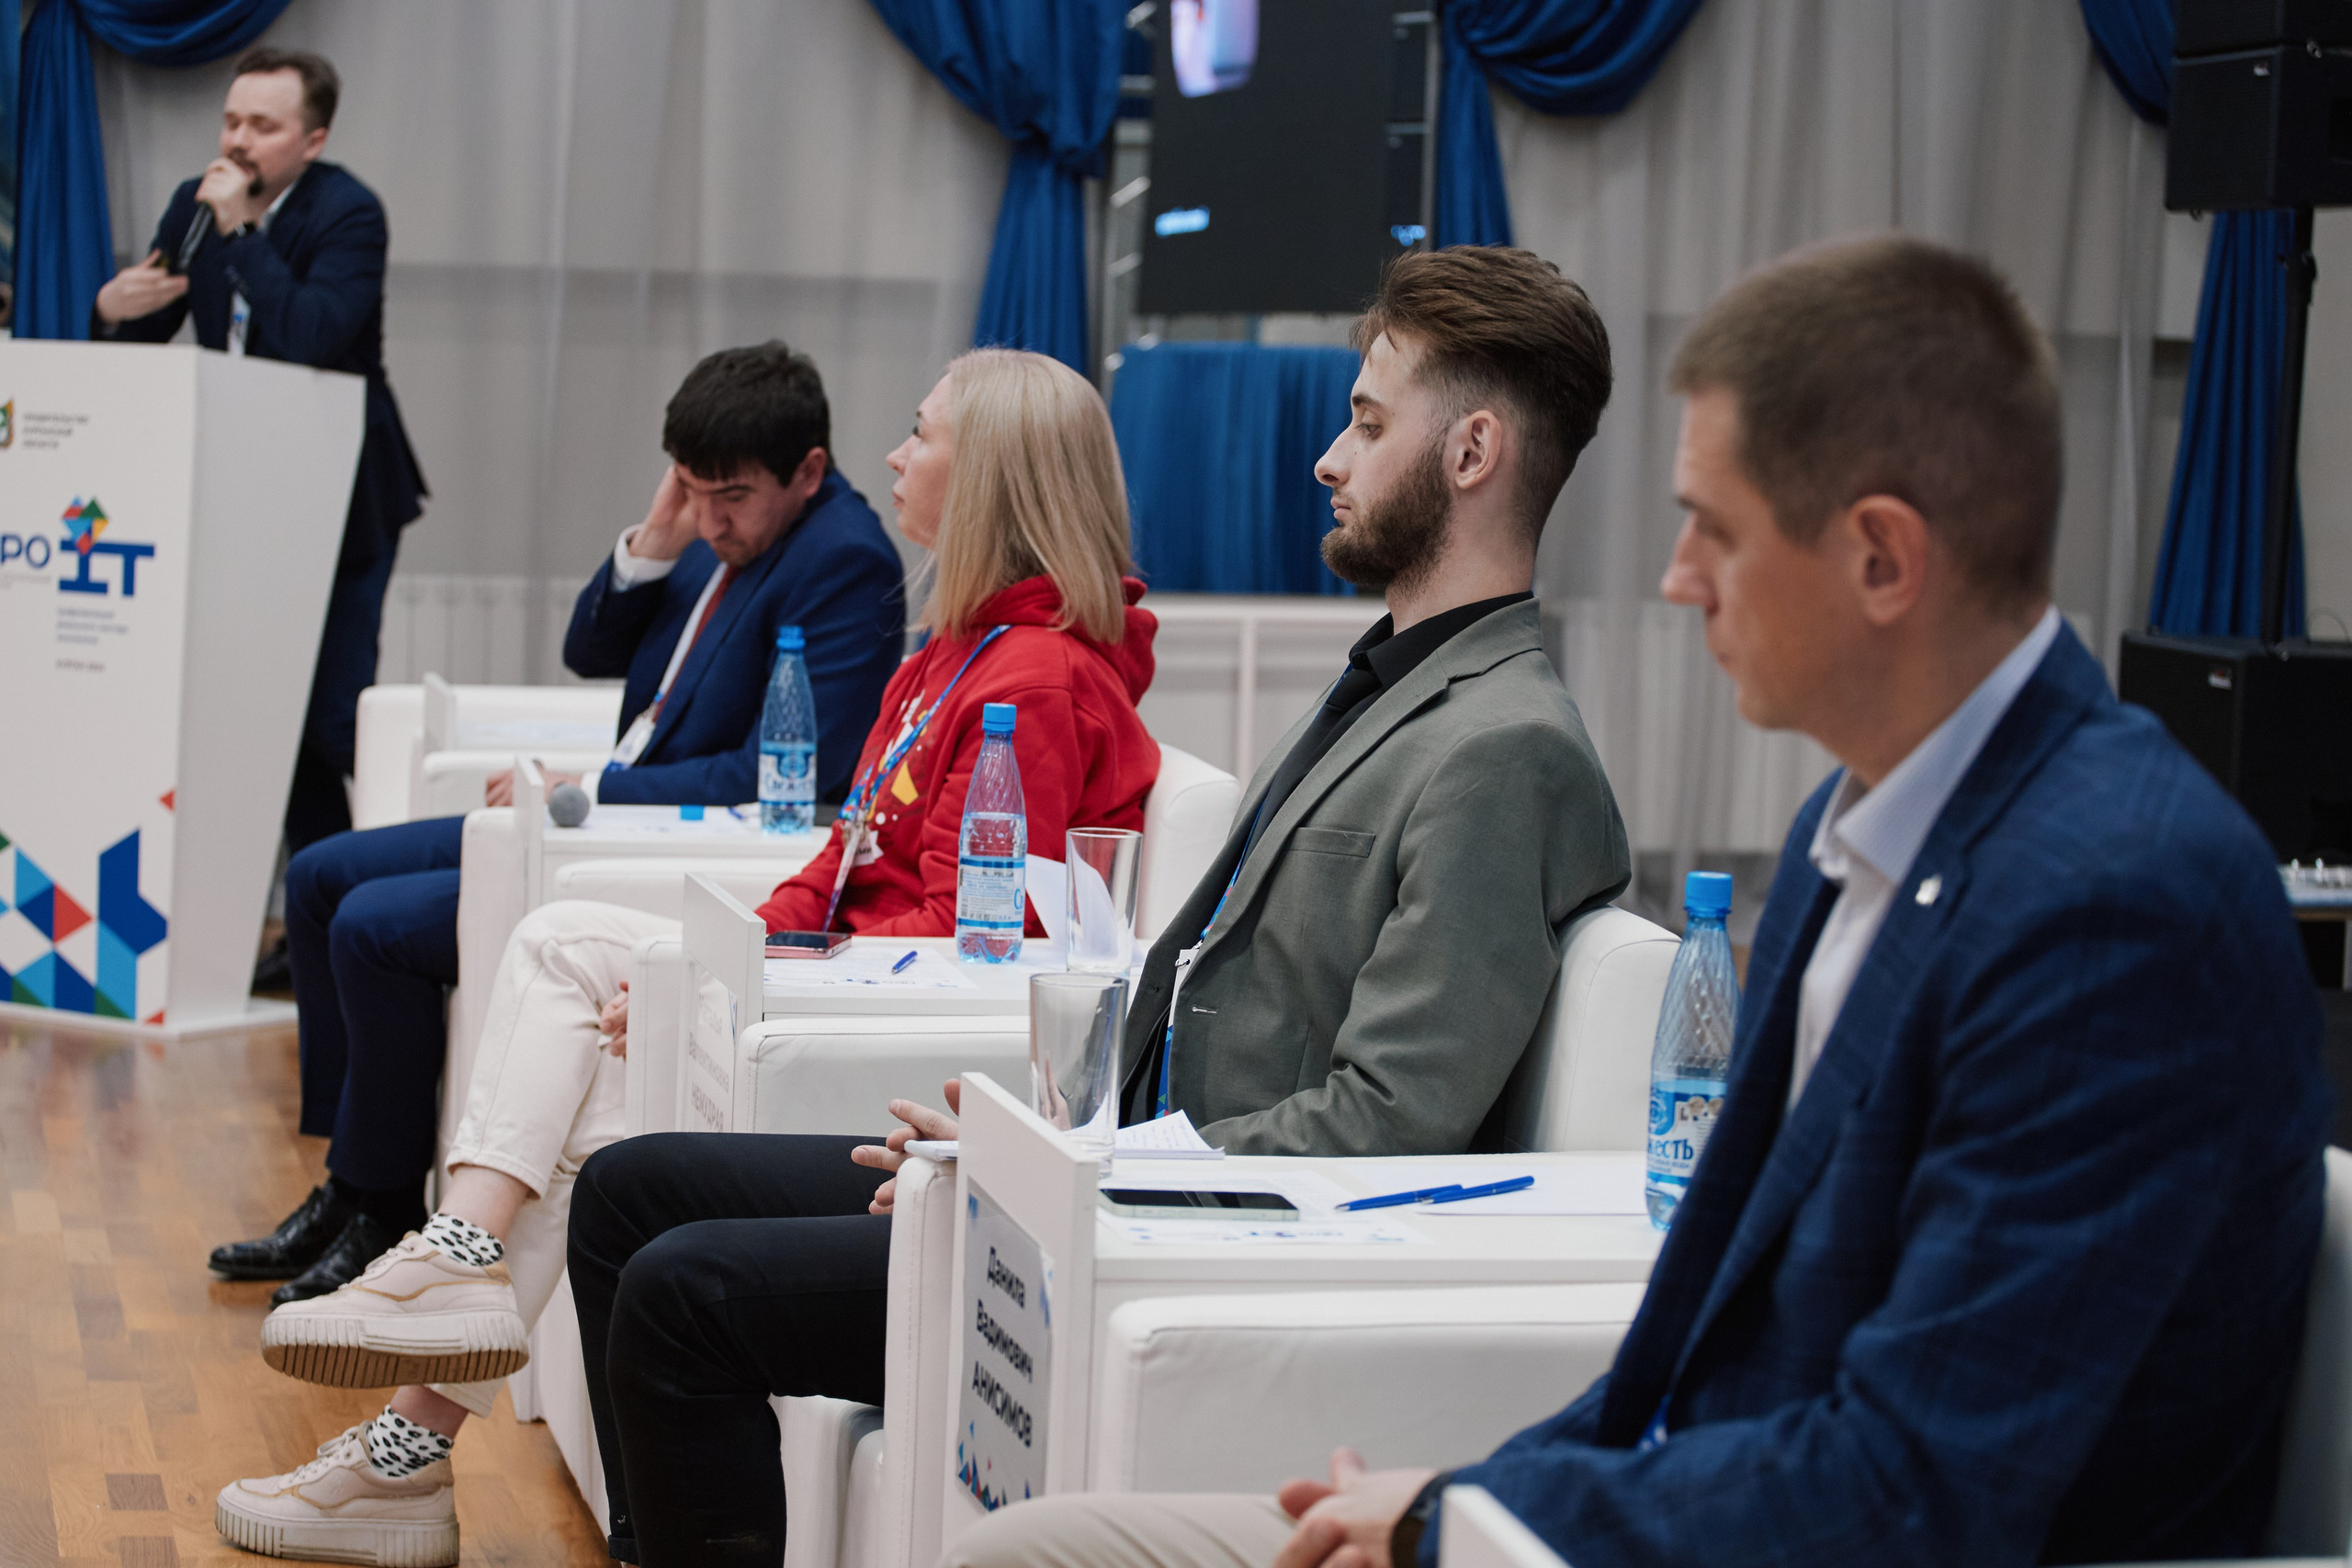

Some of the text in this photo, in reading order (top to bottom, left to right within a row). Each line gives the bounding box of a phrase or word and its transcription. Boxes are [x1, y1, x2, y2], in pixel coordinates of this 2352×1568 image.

[986, 1246, 1026, 1309] Данила
[976, 1297, 1034, 1383] Вадимович
[970, 1359, 1033, 1449] АНИСИМОВ
